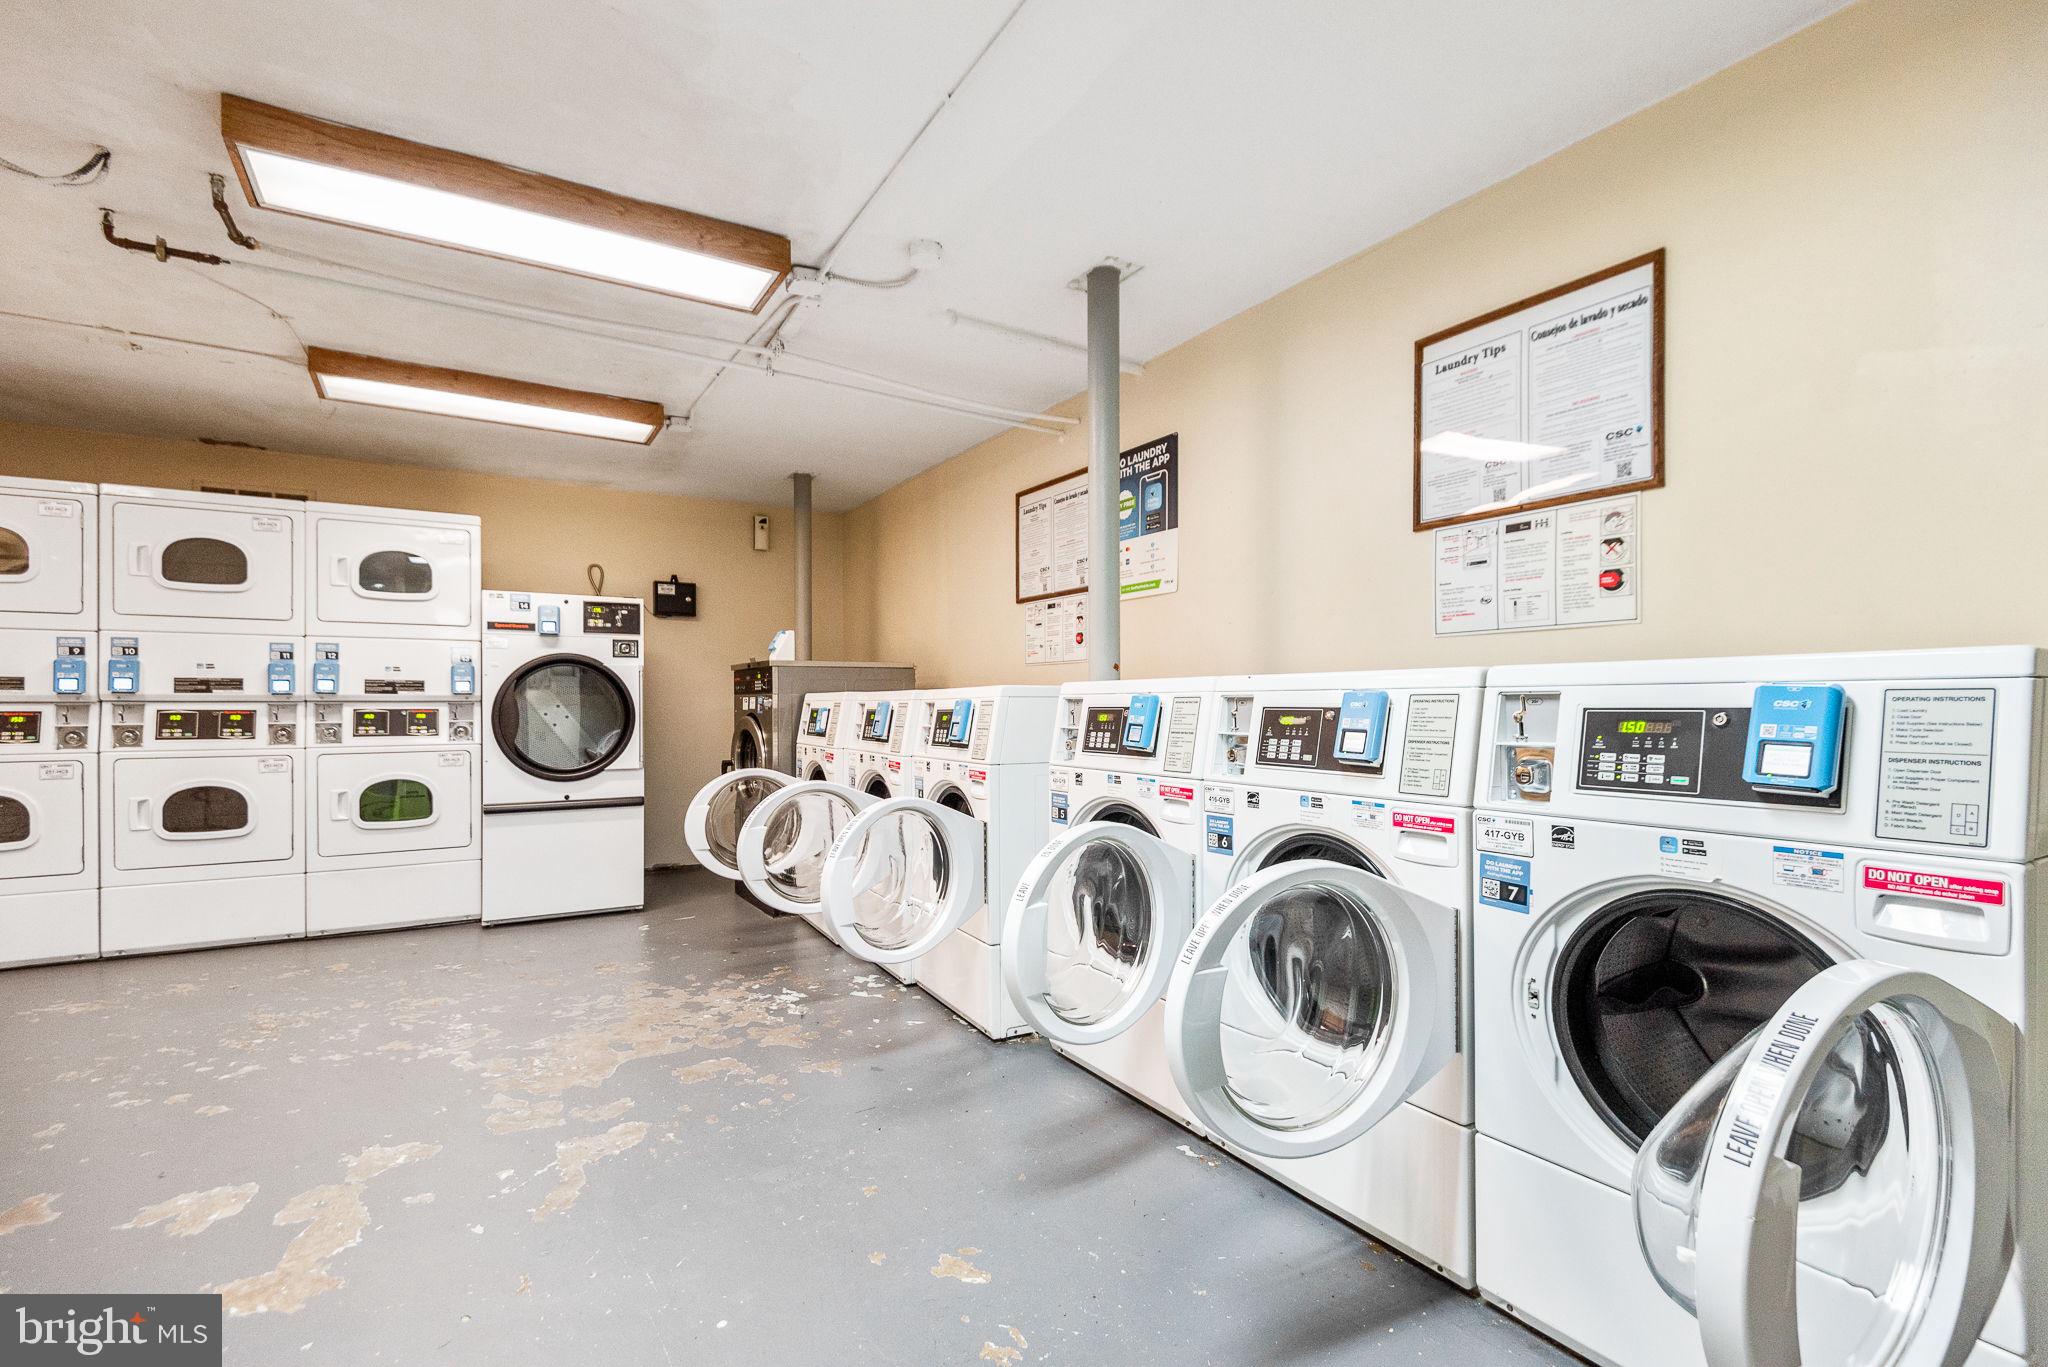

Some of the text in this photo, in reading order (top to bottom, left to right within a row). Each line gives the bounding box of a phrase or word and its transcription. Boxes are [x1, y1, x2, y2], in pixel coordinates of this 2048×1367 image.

[1531, 294, 1648, 342] Consejos de lavado y secado
[1435, 344, 1506, 375] Laundry Tips
[1605, 427, 1634, 440] CSC
[1128, 443, 1167, 466] LAUNDRY
[1120, 453, 1170, 478] ITH THE APP
[1061, 810, 1064, 818] 5
[1415, 816, 1430, 824] OPEN
[1222, 837, 1228, 847] 6
[1485, 830, 1525, 841] 417-GYB
[1495, 862, 1521, 870] LAUNDRY
[1868, 869, 1885, 880] DO
[1888, 871, 1912, 883] NOT
[1914, 874, 1949, 888] OPEN
[1508, 886, 1518, 900] 7
[1181, 939, 1200, 965] LEAVE
[1195, 920, 1210, 938] OPE
[1229, 884, 1250, 898] DONE
[1778, 1012, 1820, 1042] DONE
